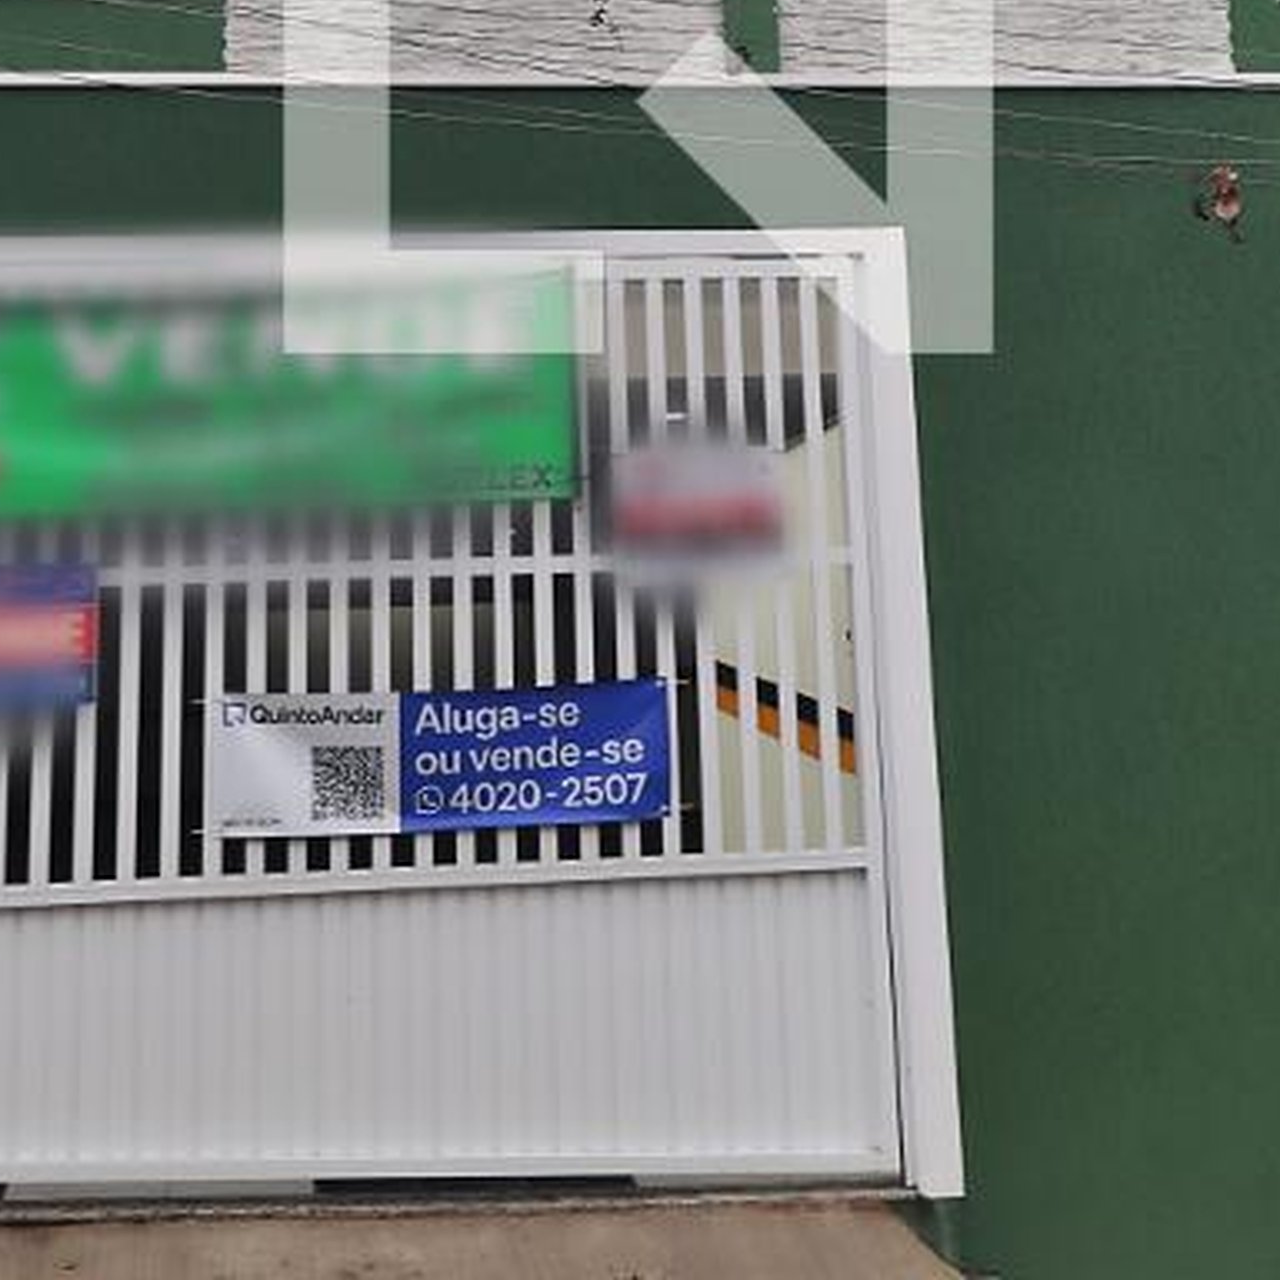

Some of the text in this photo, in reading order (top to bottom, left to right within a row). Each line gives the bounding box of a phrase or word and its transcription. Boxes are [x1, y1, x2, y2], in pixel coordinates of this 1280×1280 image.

[249, 702, 384, 725] QuintoAndar
[415, 702, 580, 740] Aluga-se
[415, 736, 645, 775] ou vende-se
[450, 772, 648, 814] 4020-2507
